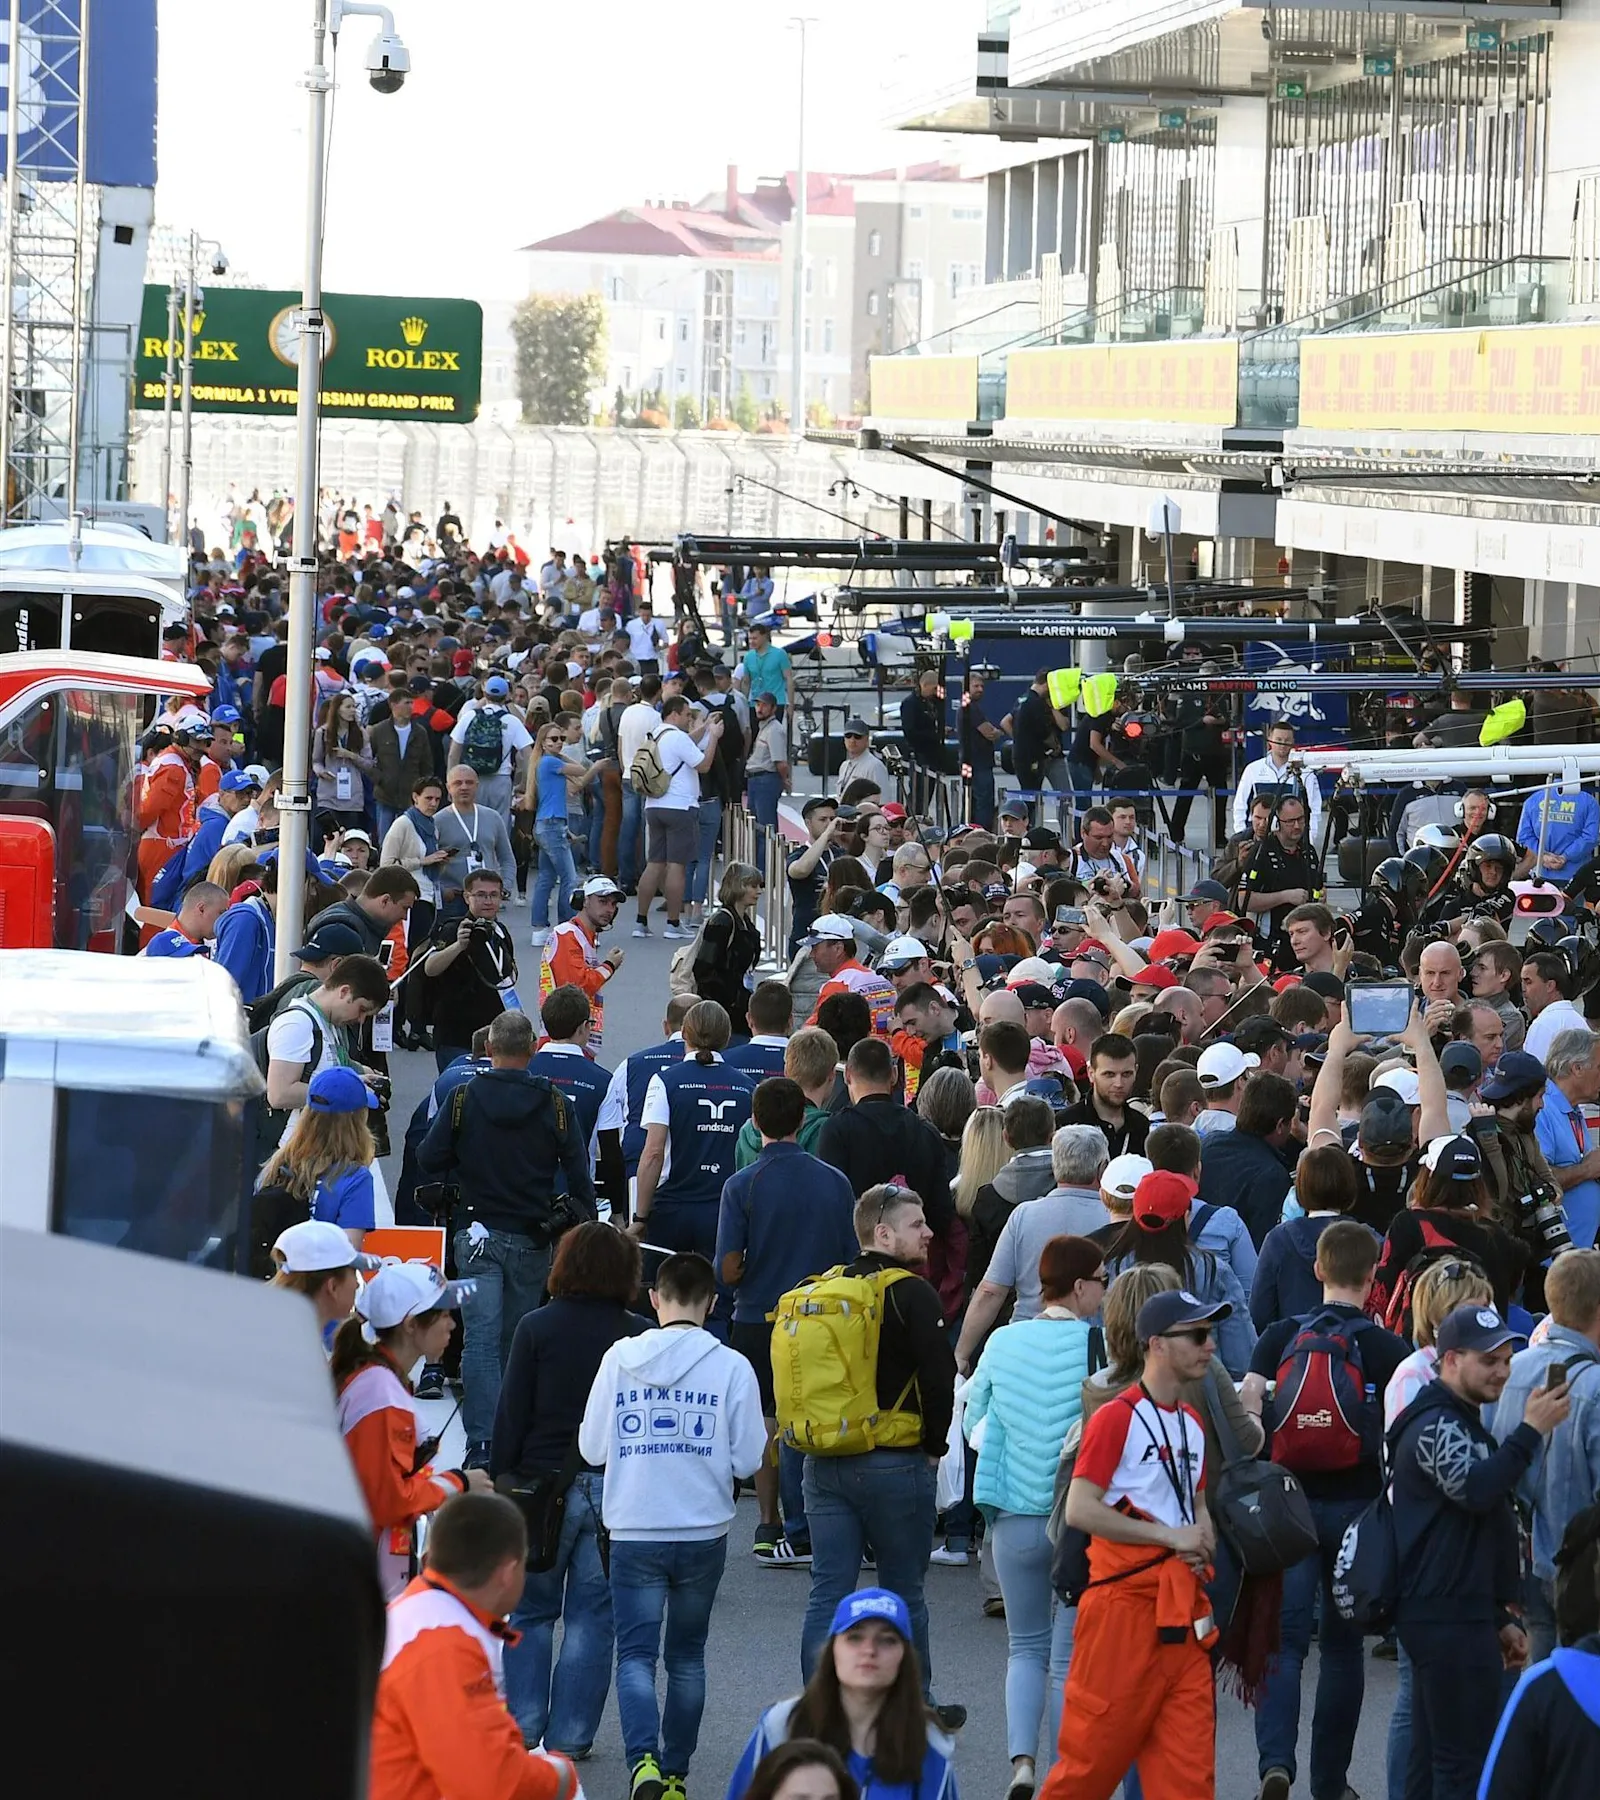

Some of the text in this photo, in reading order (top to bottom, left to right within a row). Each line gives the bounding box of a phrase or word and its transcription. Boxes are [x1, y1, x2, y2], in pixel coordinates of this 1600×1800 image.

[366, 348, 460, 371] ROLEX
[143, 383, 181, 399] 207
[257, 388, 266, 402] 1
[367, 393, 418, 409] GRAND
[421, 395, 455, 411] PRIX
[15, 609, 29, 652] ndia
[1020, 625, 1117, 637] McLAREN HONDA
[1160, 681, 1297, 691] ILLAMS MARTINI RACING
[697, 1121, 735, 1133] randstad
[789, 1341, 804, 1413] Marmot
[615, 1388, 719, 1408] ДВИЖЕНИЕ
[1297, 1413, 1332, 1423] SOCHI
[619, 1443, 713, 1459] ДО ИЗНЕМОЖЕНИЯ
